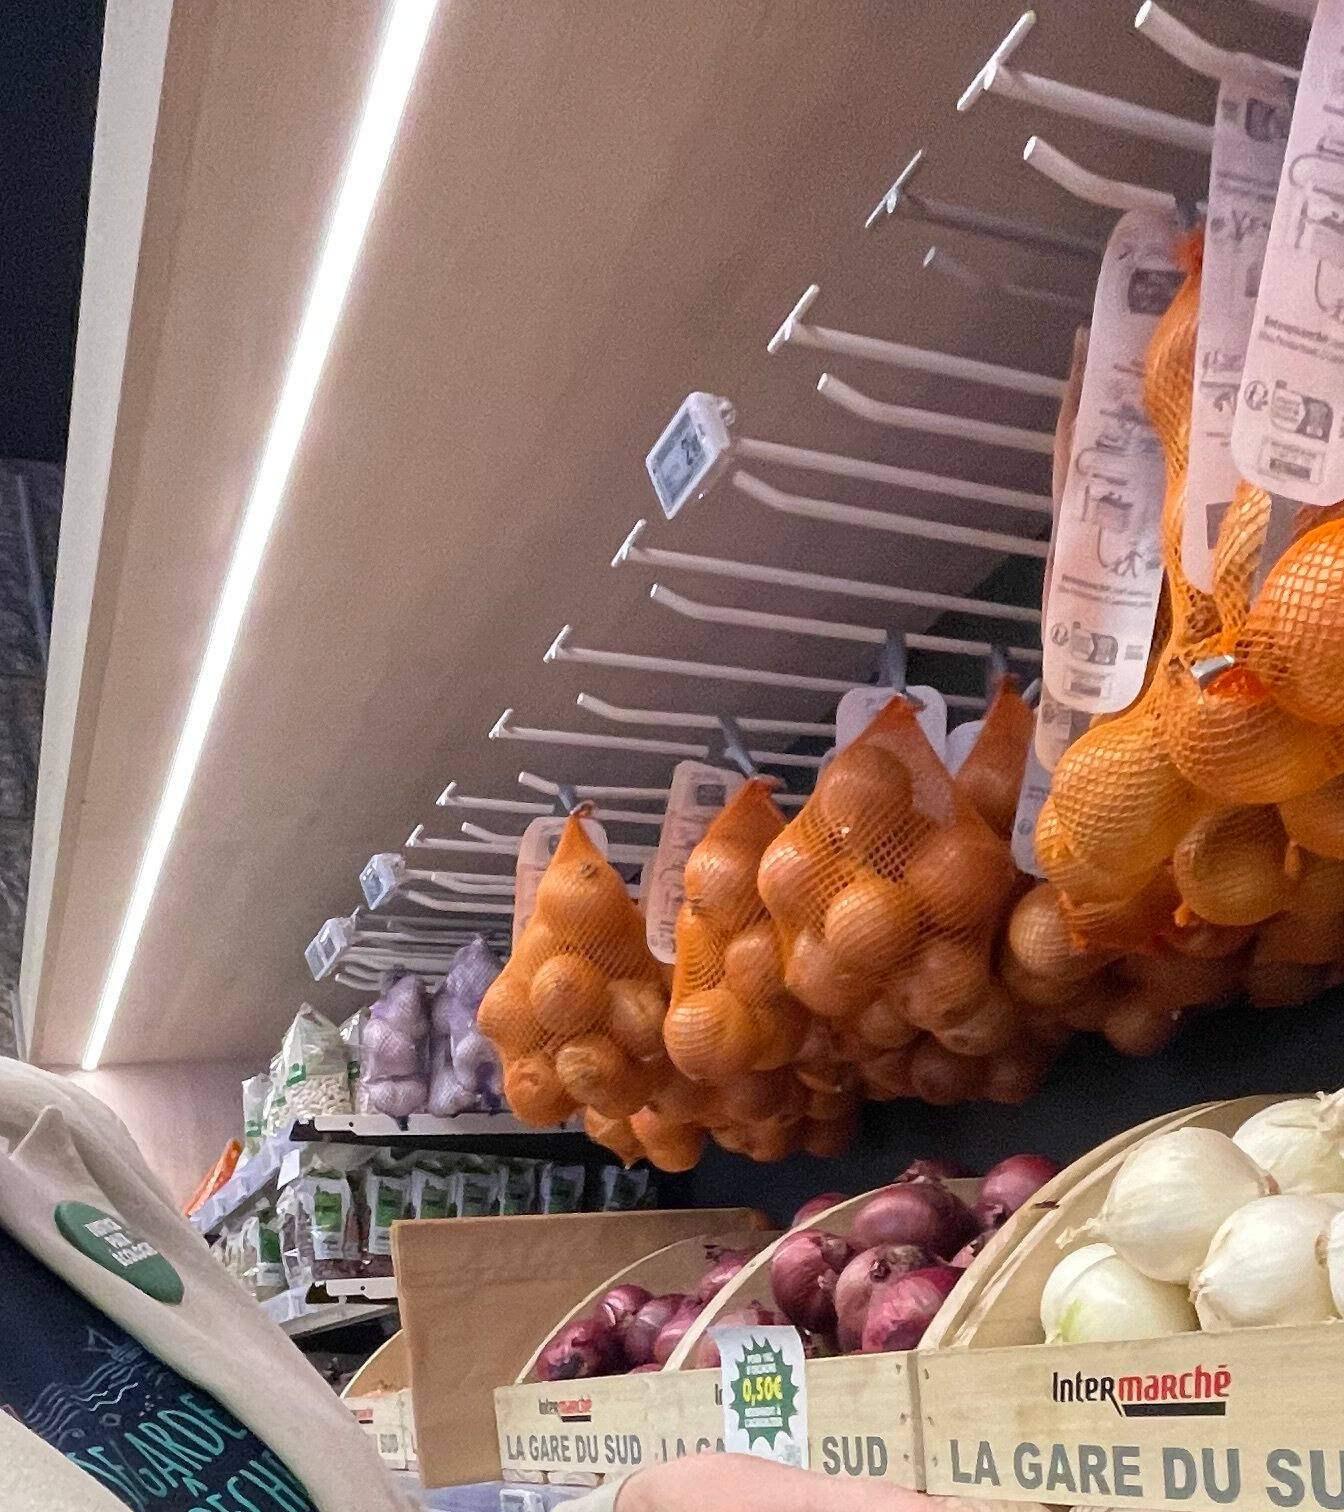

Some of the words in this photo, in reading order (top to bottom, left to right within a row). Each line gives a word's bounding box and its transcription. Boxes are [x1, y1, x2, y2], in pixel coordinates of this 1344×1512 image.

[109, 1393, 248, 1497] GARDE
[507, 1434, 526, 1461] LA
[529, 1434, 572, 1462] GARE
[575, 1434, 599, 1463] DU
[604, 1434, 642, 1465] SUD
[822, 1436, 888, 1477] SUD
[949, 1439, 1001, 1486] LA
[1013, 1442, 1142, 1497] GARE
[1162, 1447, 1241, 1504] DU
